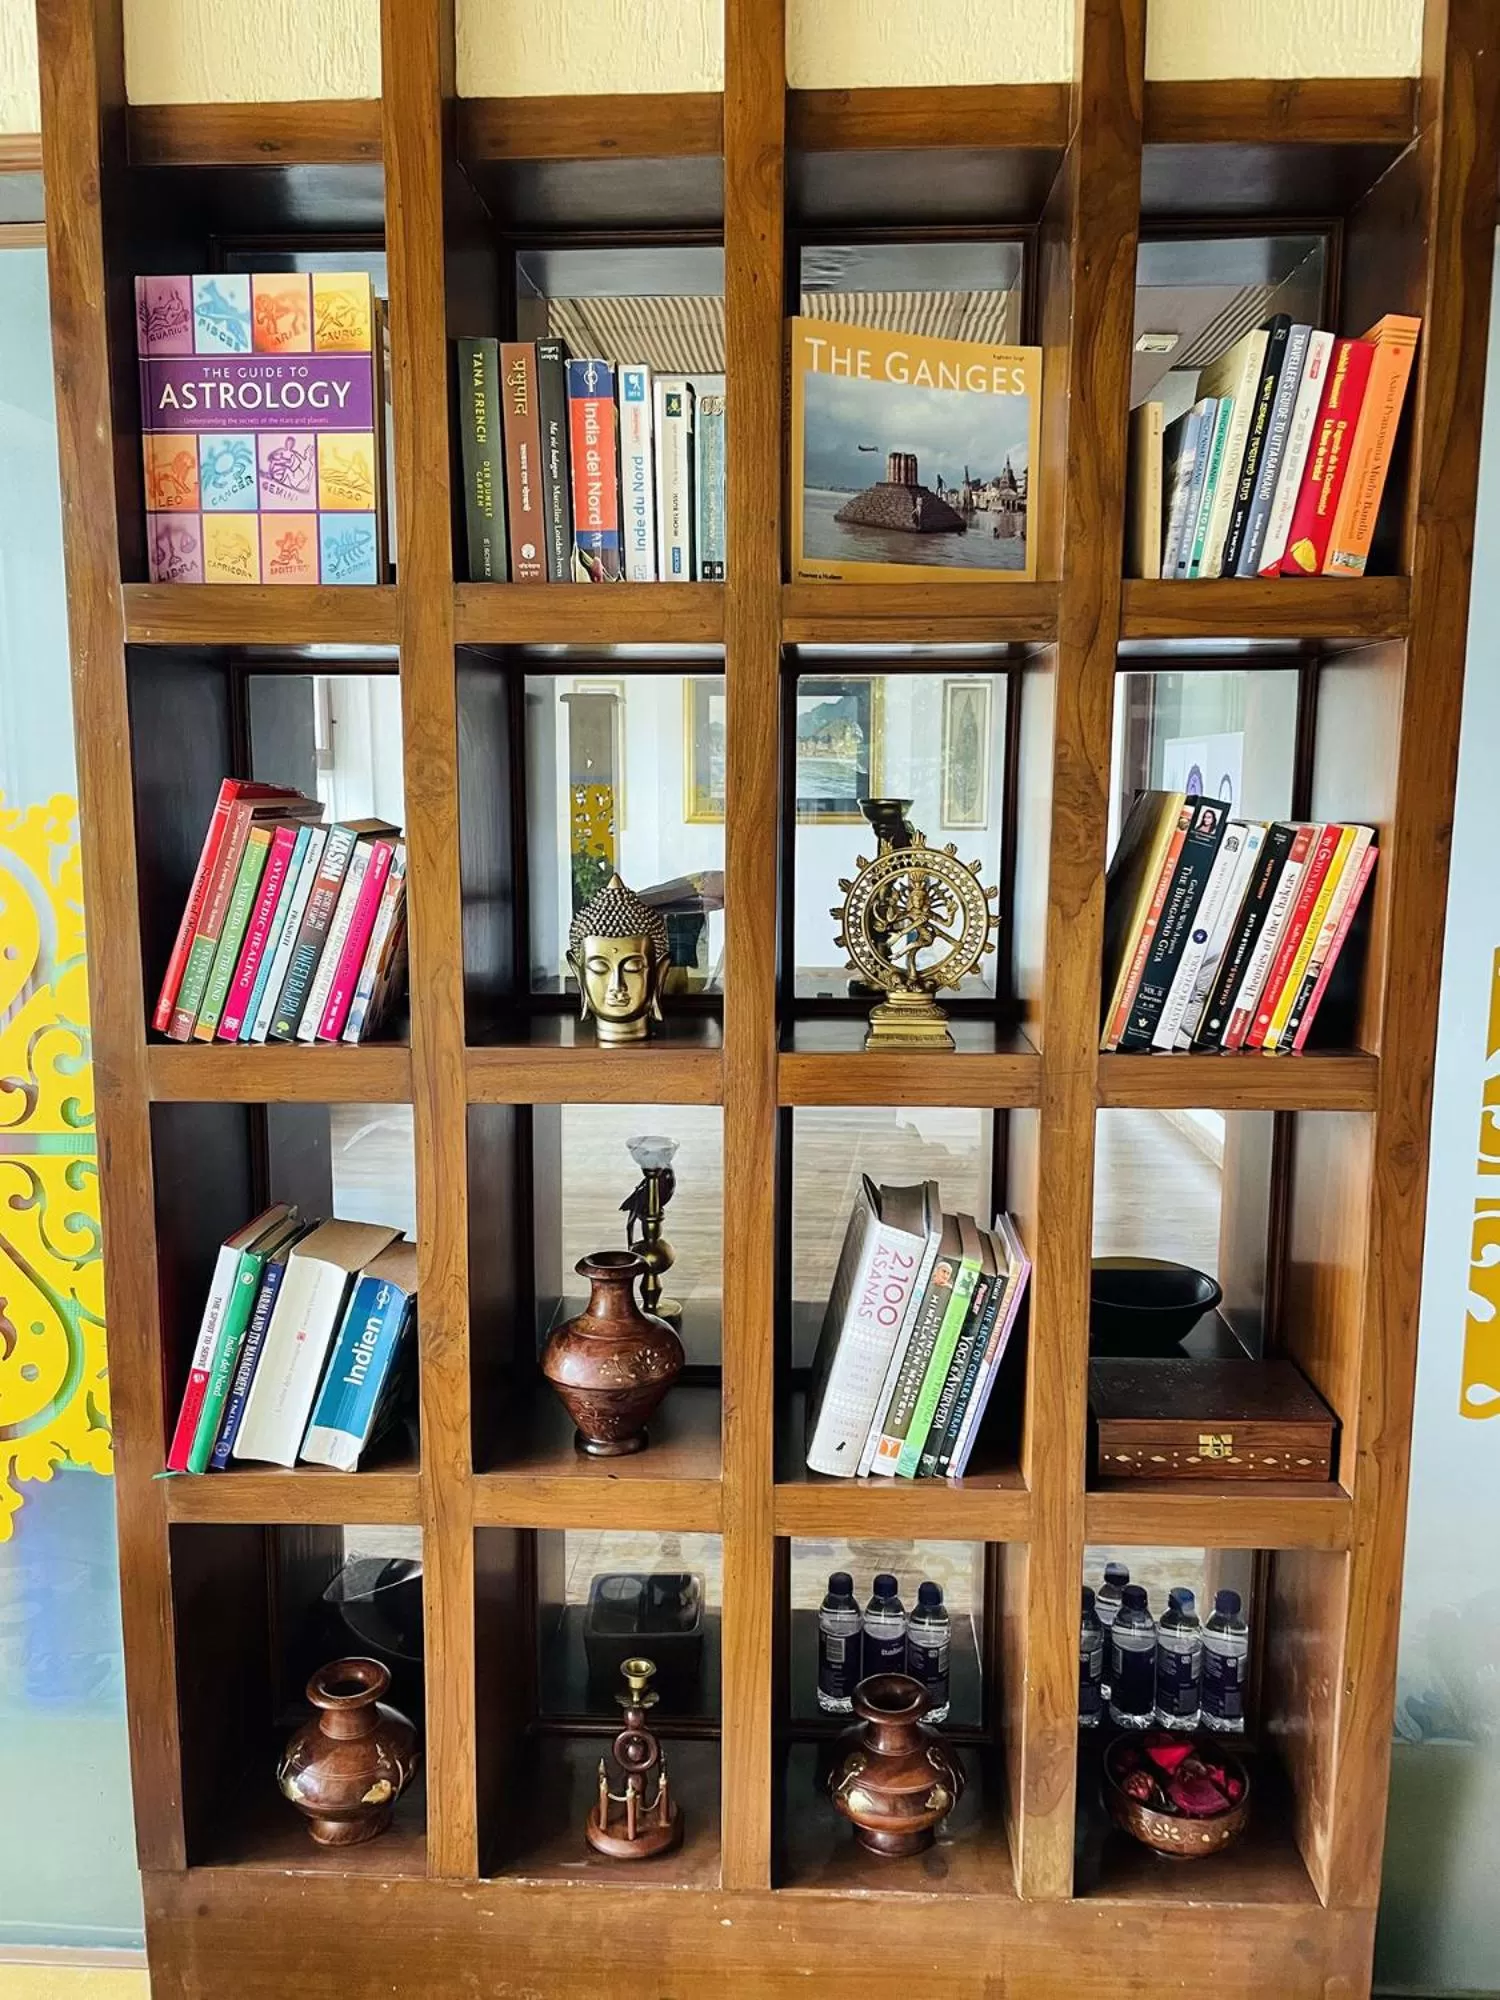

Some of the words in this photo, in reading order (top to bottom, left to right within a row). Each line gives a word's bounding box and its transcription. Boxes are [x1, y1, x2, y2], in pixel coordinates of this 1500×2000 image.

[320, 328, 364, 343] TAURUS
[203, 368, 230, 378] THE
[238, 367, 282, 378] GUIDE
[289, 367, 308, 377] TO
[472, 352, 483, 386] TANA
[805, 337, 872, 380] THE
[885, 351, 1025, 396] GANGES
[1283, 332, 1304, 390] TRAVELLER'S
[159, 381, 351, 409] ASTROLOGY
[506, 358, 528, 416] प्रभुपाद
[1385, 372, 1402, 403] Asana
[474, 391, 486, 442] FRENCH
[1217, 408, 1228, 432] THICH
[1276, 391, 1291, 420] GUIDE
[584, 402, 600, 445] India
[1201, 411, 1212, 436] THICH
[1371, 404, 1394, 462] Pranayama
[1197, 436, 1207, 458] NHAT
[1213, 434, 1223, 456] NHAT
[586, 449, 601, 475] del
[631, 455, 643, 491] Nord
[1192, 461, 1203, 484] HANH
[1207, 459, 1218, 482] HANH
[1258, 433, 1282, 501] UTTARAKHAND
[211, 475, 254, 506] CANCER
[262, 480, 298, 502] GEMINI
[327, 486, 362, 501] VIRGO
[476, 471, 484, 506] GARTEN
[1364, 463, 1381, 499] Mudra
[158, 496, 183, 507] LEO
[483, 481, 492, 517] DUNKLE
[552, 485, 561, 522] Marceline
[587, 482, 602, 524] Nord
[633, 496, 644, 514] du
[1188, 490, 1198, 508] HOW
[1202, 488, 1213, 510] HOW
[634, 518, 645, 551] Inde
[1196, 526, 1206, 542] EAT
[1355, 500, 1373, 542] Bandha
[158, 560, 198, 582] LIBRA
[319, 828, 352, 883] KASHI
[192, 865, 211, 904] Secrets
[1178, 863, 1193, 886] THE
[1186, 878, 1198, 894] God
[229, 878, 251, 930] AYURVEDA
[255, 857, 283, 929] AYURVEDIC
[1180, 894, 1192, 914] Talks
[1271, 871, 1296, 917] Chakras
[1320, 886, 1332, 900] The
[1161, 887, 1186, 937] BHAGAVAD
[1174, 914, 1185, 931] With
[1307, 902, 1326, 935] Chakra
[1264, 917, 1280, 937] the
[223, 933, 236, 952] AND
[1138, 933, 1151, 953] YOGA
[1152, 938, 1169, 964] GITA
[1165, 930, 1180, 955] Arjuna
[1291, 934, 1314, 978] Handbook
[218, 953, 230, 972] THE
[238, 931, 262, 988] HEALING
[291, 941, 316, 978] VINEET
[1132, 953, 1144, 970] FOR
[210, 973, 226, 1001] MIND
[1120, 969, 1139, 1009] EVERYONE
[1243, 951, 1268, 998] Theories
[279, 978, 305, 1017] BAJPAI
[857, 1244, 890, 1319] ASANAS
[873, 1250, 914, 1327] 2,100
[211, 1296, 222, 1311] THE
[255, 1285, 273, 1314] MARMA
[983, 1304, 995, 1323] THE
[206, 1311, 218, 1334] SPIRIT
[250, 1314, 265, 1332] AND
[911, 1294, 939, 1365] HIMALAYAN
[922, 1315, 941, 1358] LIVING
[975, 1324, 989, 1348] ABC'S
[197, 1345, 210, 1368] SERVE
[222, 1334, 236, 1358] India
[341, 1314, 383, 1387] Indien
[953, 1333, 974, 1365] YOGA
[218, 1358, 230, 1374] del
[232, 1344, 256, 1396] MANAGEMENT
[913, 1360, 927, 1386] WITH
[212, 1374, 225, 1397] Nord
[959, 1363, 977, 1399] CHAKRA
[892, 1368, 916, 1425] MASTERS
[906, 1388, 918, 1408] THE
[932, 1370, 961, 1431] AYURVEDA
[947, 1400, 965, 1438] THERAPY
